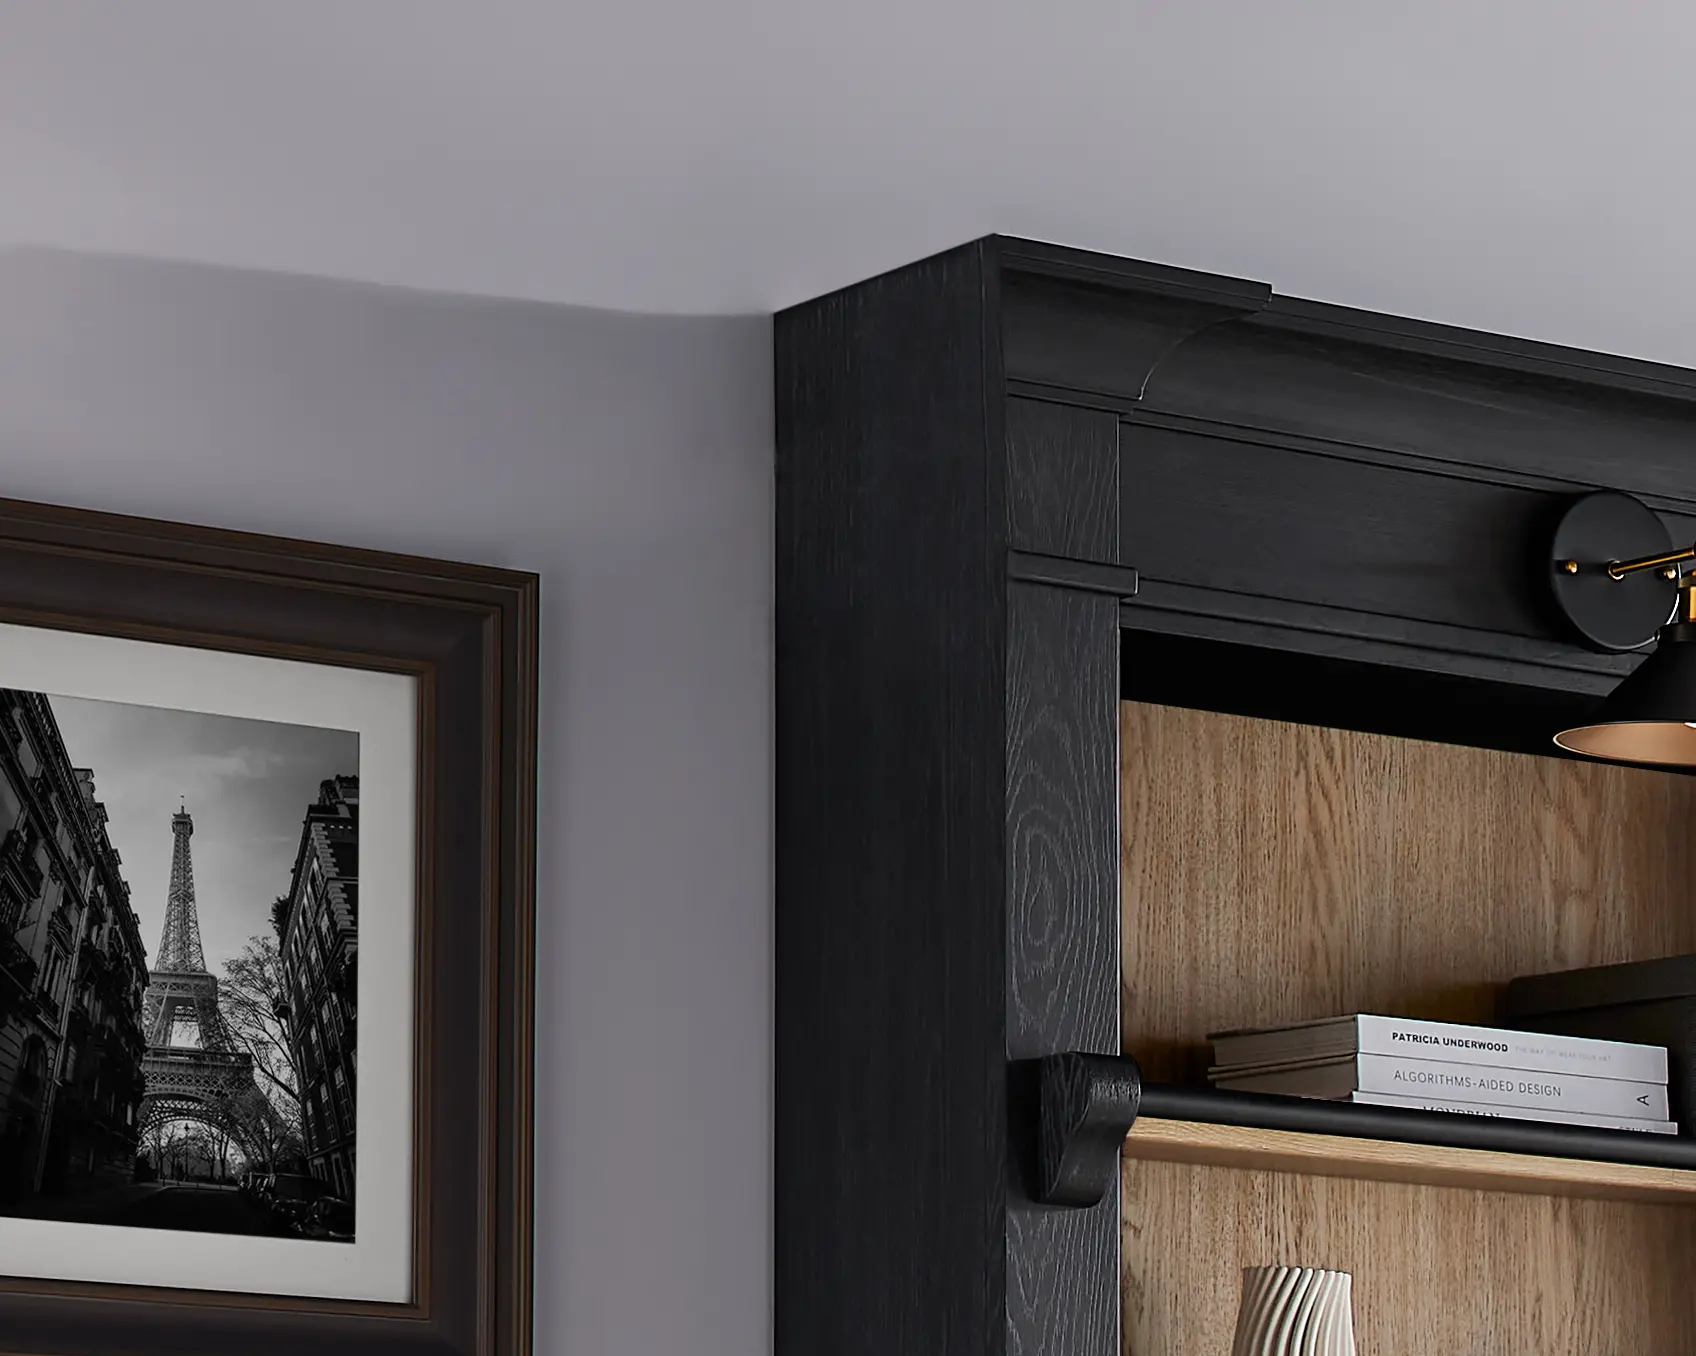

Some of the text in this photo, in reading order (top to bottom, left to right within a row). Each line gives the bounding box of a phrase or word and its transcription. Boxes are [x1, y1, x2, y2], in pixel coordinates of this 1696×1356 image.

[1392, 1032, 1508, 1053] PATRICIA UNDERWOOD
[1394, 1070, 1562, 1097] ALGORITHMS-AIDED DESIGN
